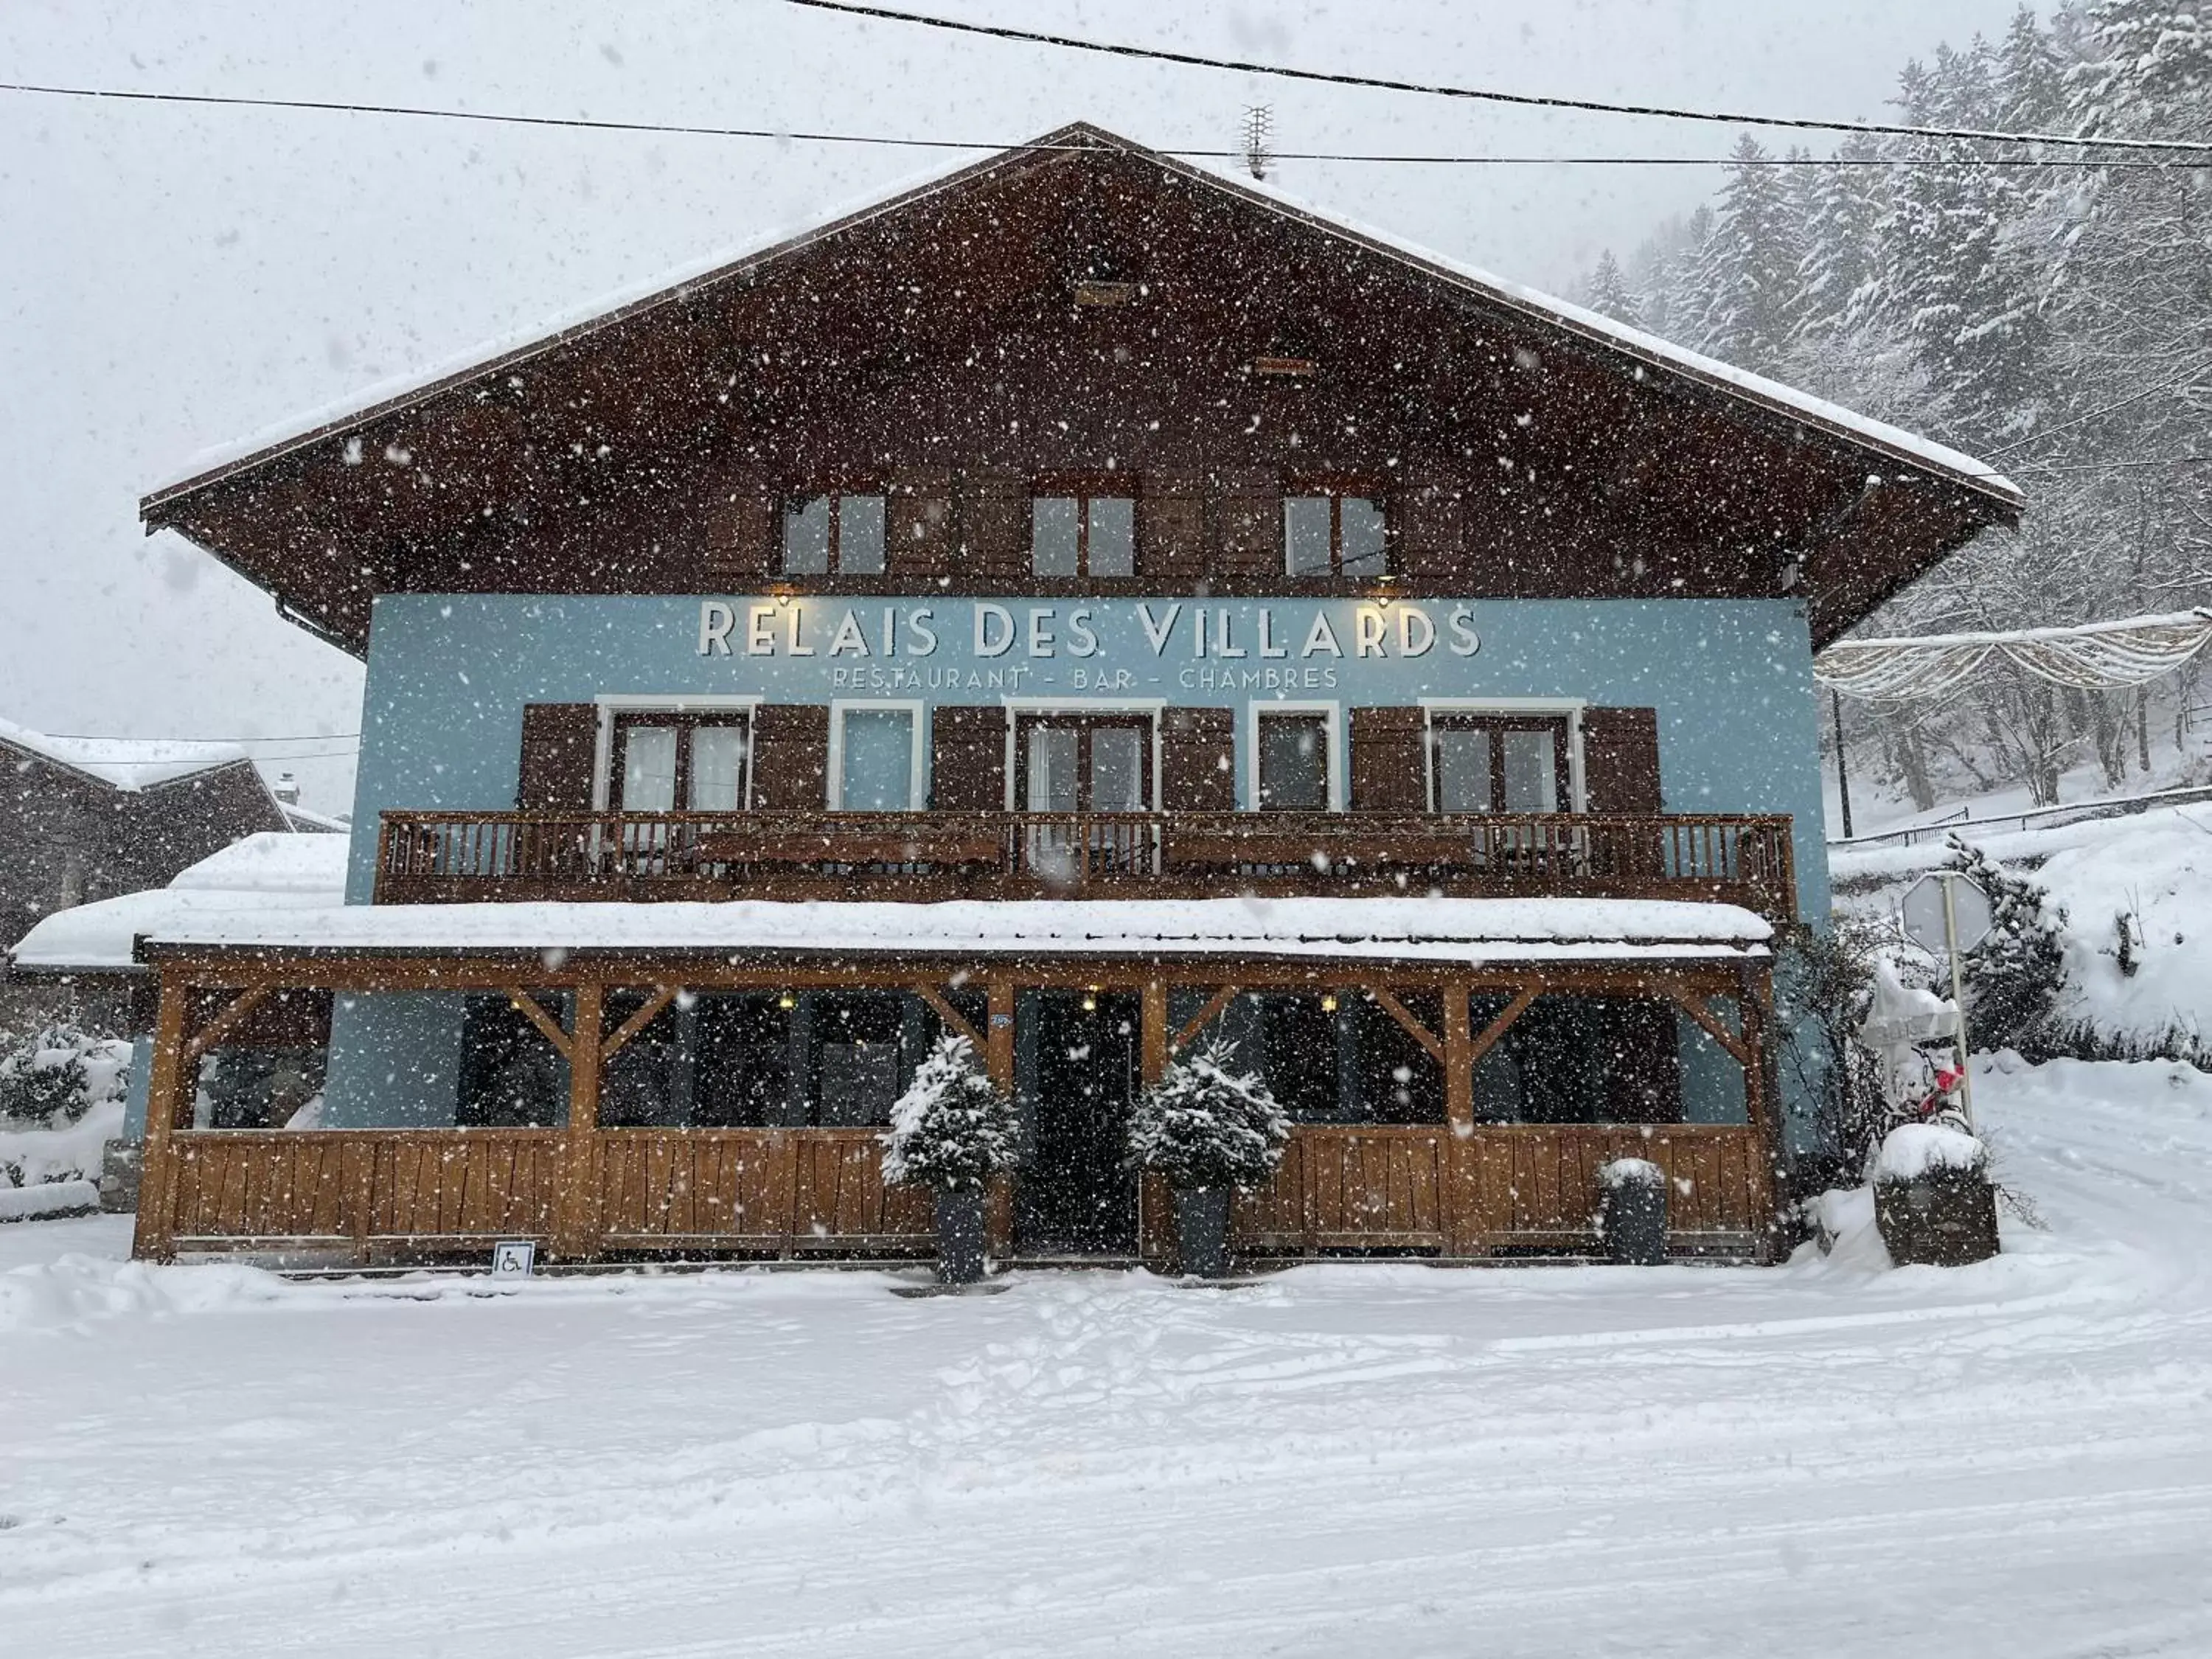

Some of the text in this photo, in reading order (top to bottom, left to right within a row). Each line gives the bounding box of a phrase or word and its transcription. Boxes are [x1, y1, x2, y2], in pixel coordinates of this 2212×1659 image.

[700, 600, 1481, 658] RELAIS DES VILLARDS
[833, 667, 1029, 690] RESTAURANT
[1074, 668, 1133, 690] BAR
[1180, 668, 1338, 690] CHAMBRES
